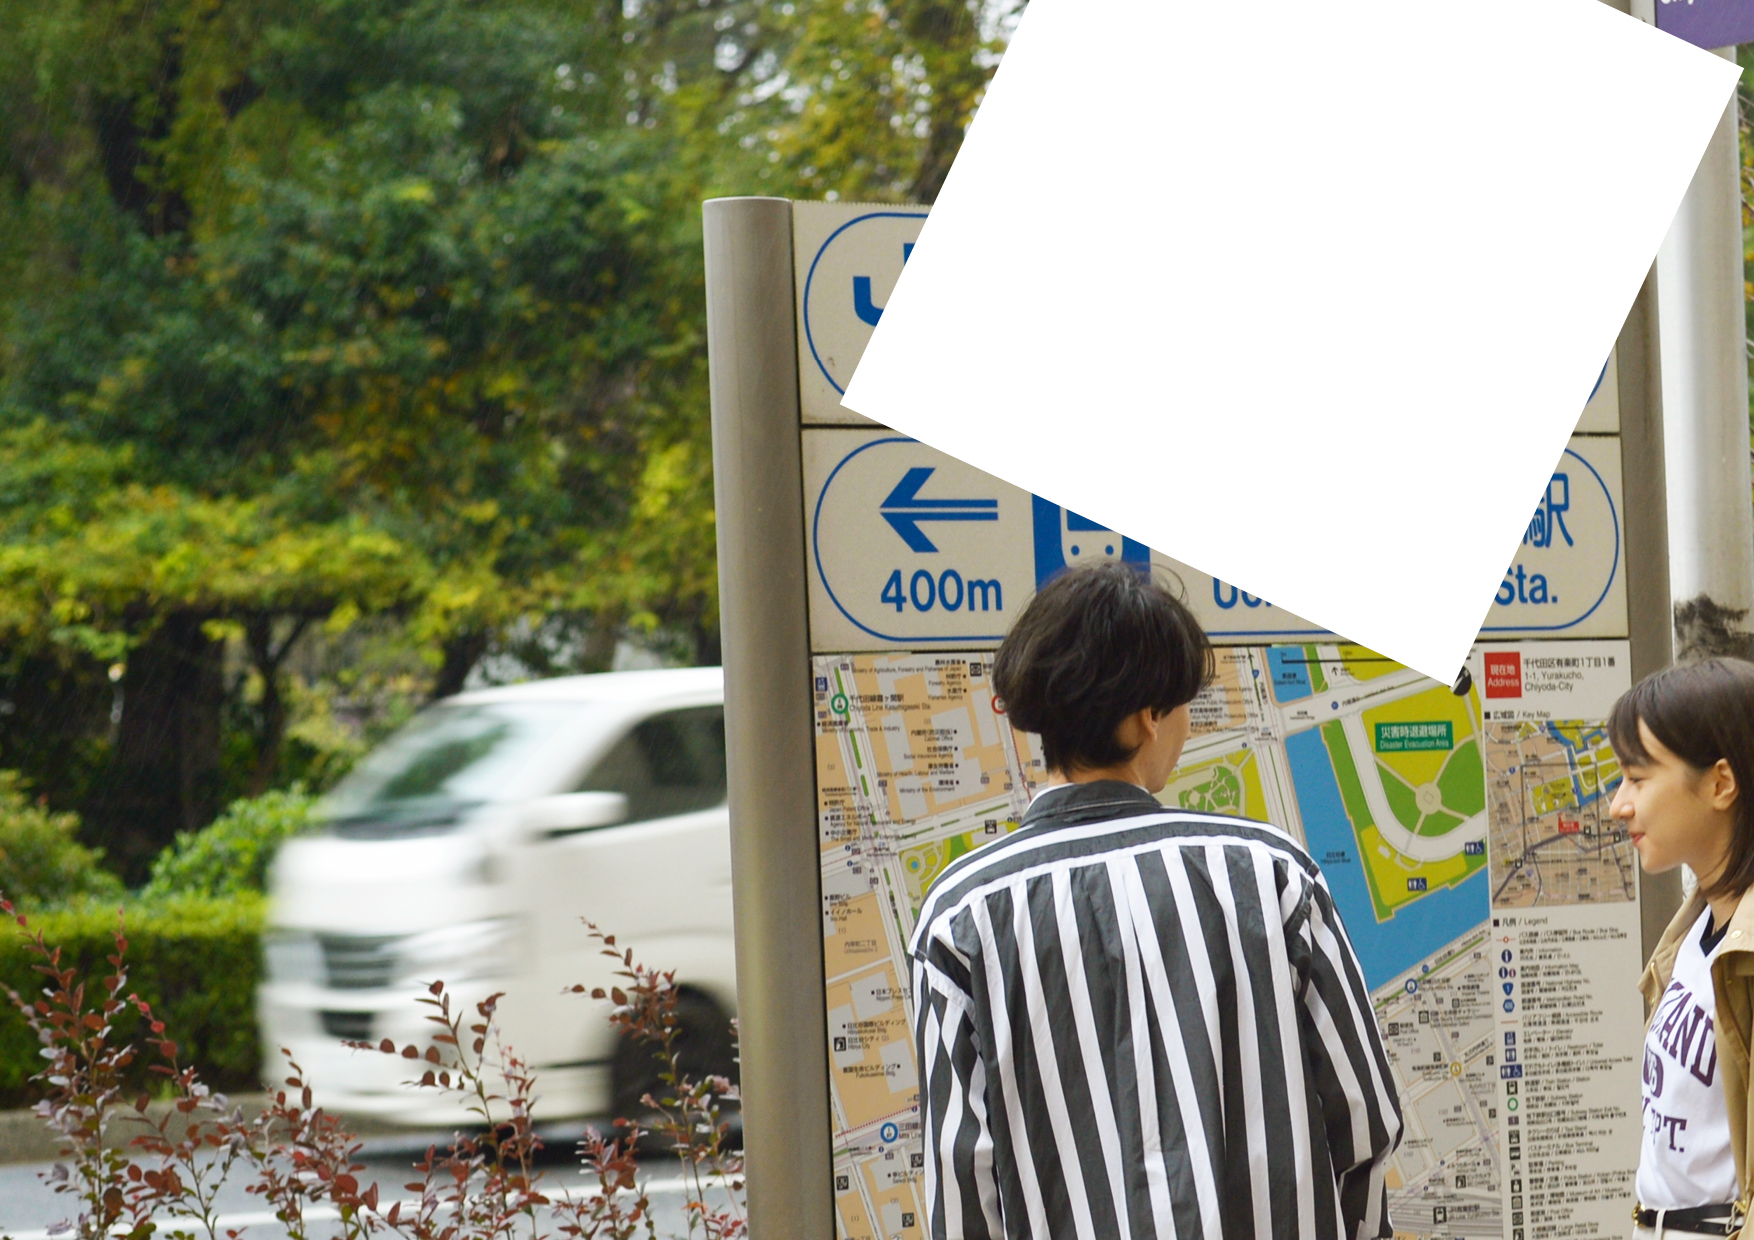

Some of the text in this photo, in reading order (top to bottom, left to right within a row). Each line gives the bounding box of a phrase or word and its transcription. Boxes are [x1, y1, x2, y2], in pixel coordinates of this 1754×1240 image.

[881, 568, 1003, 613] 400m
[1490, 665, 1516, 676] 現在地
[1487, 677, 1520, 688] Address
[1522, 710, 1535, 720] Key
[1536, 710, 1551, 719] Map
[1381, 724, 1447, 739] 災害時退避場所
[1380, 738, 1450, 750] Disaster Evacuation Area
[1502, 917, 1548, 927] 凡例 Legend
